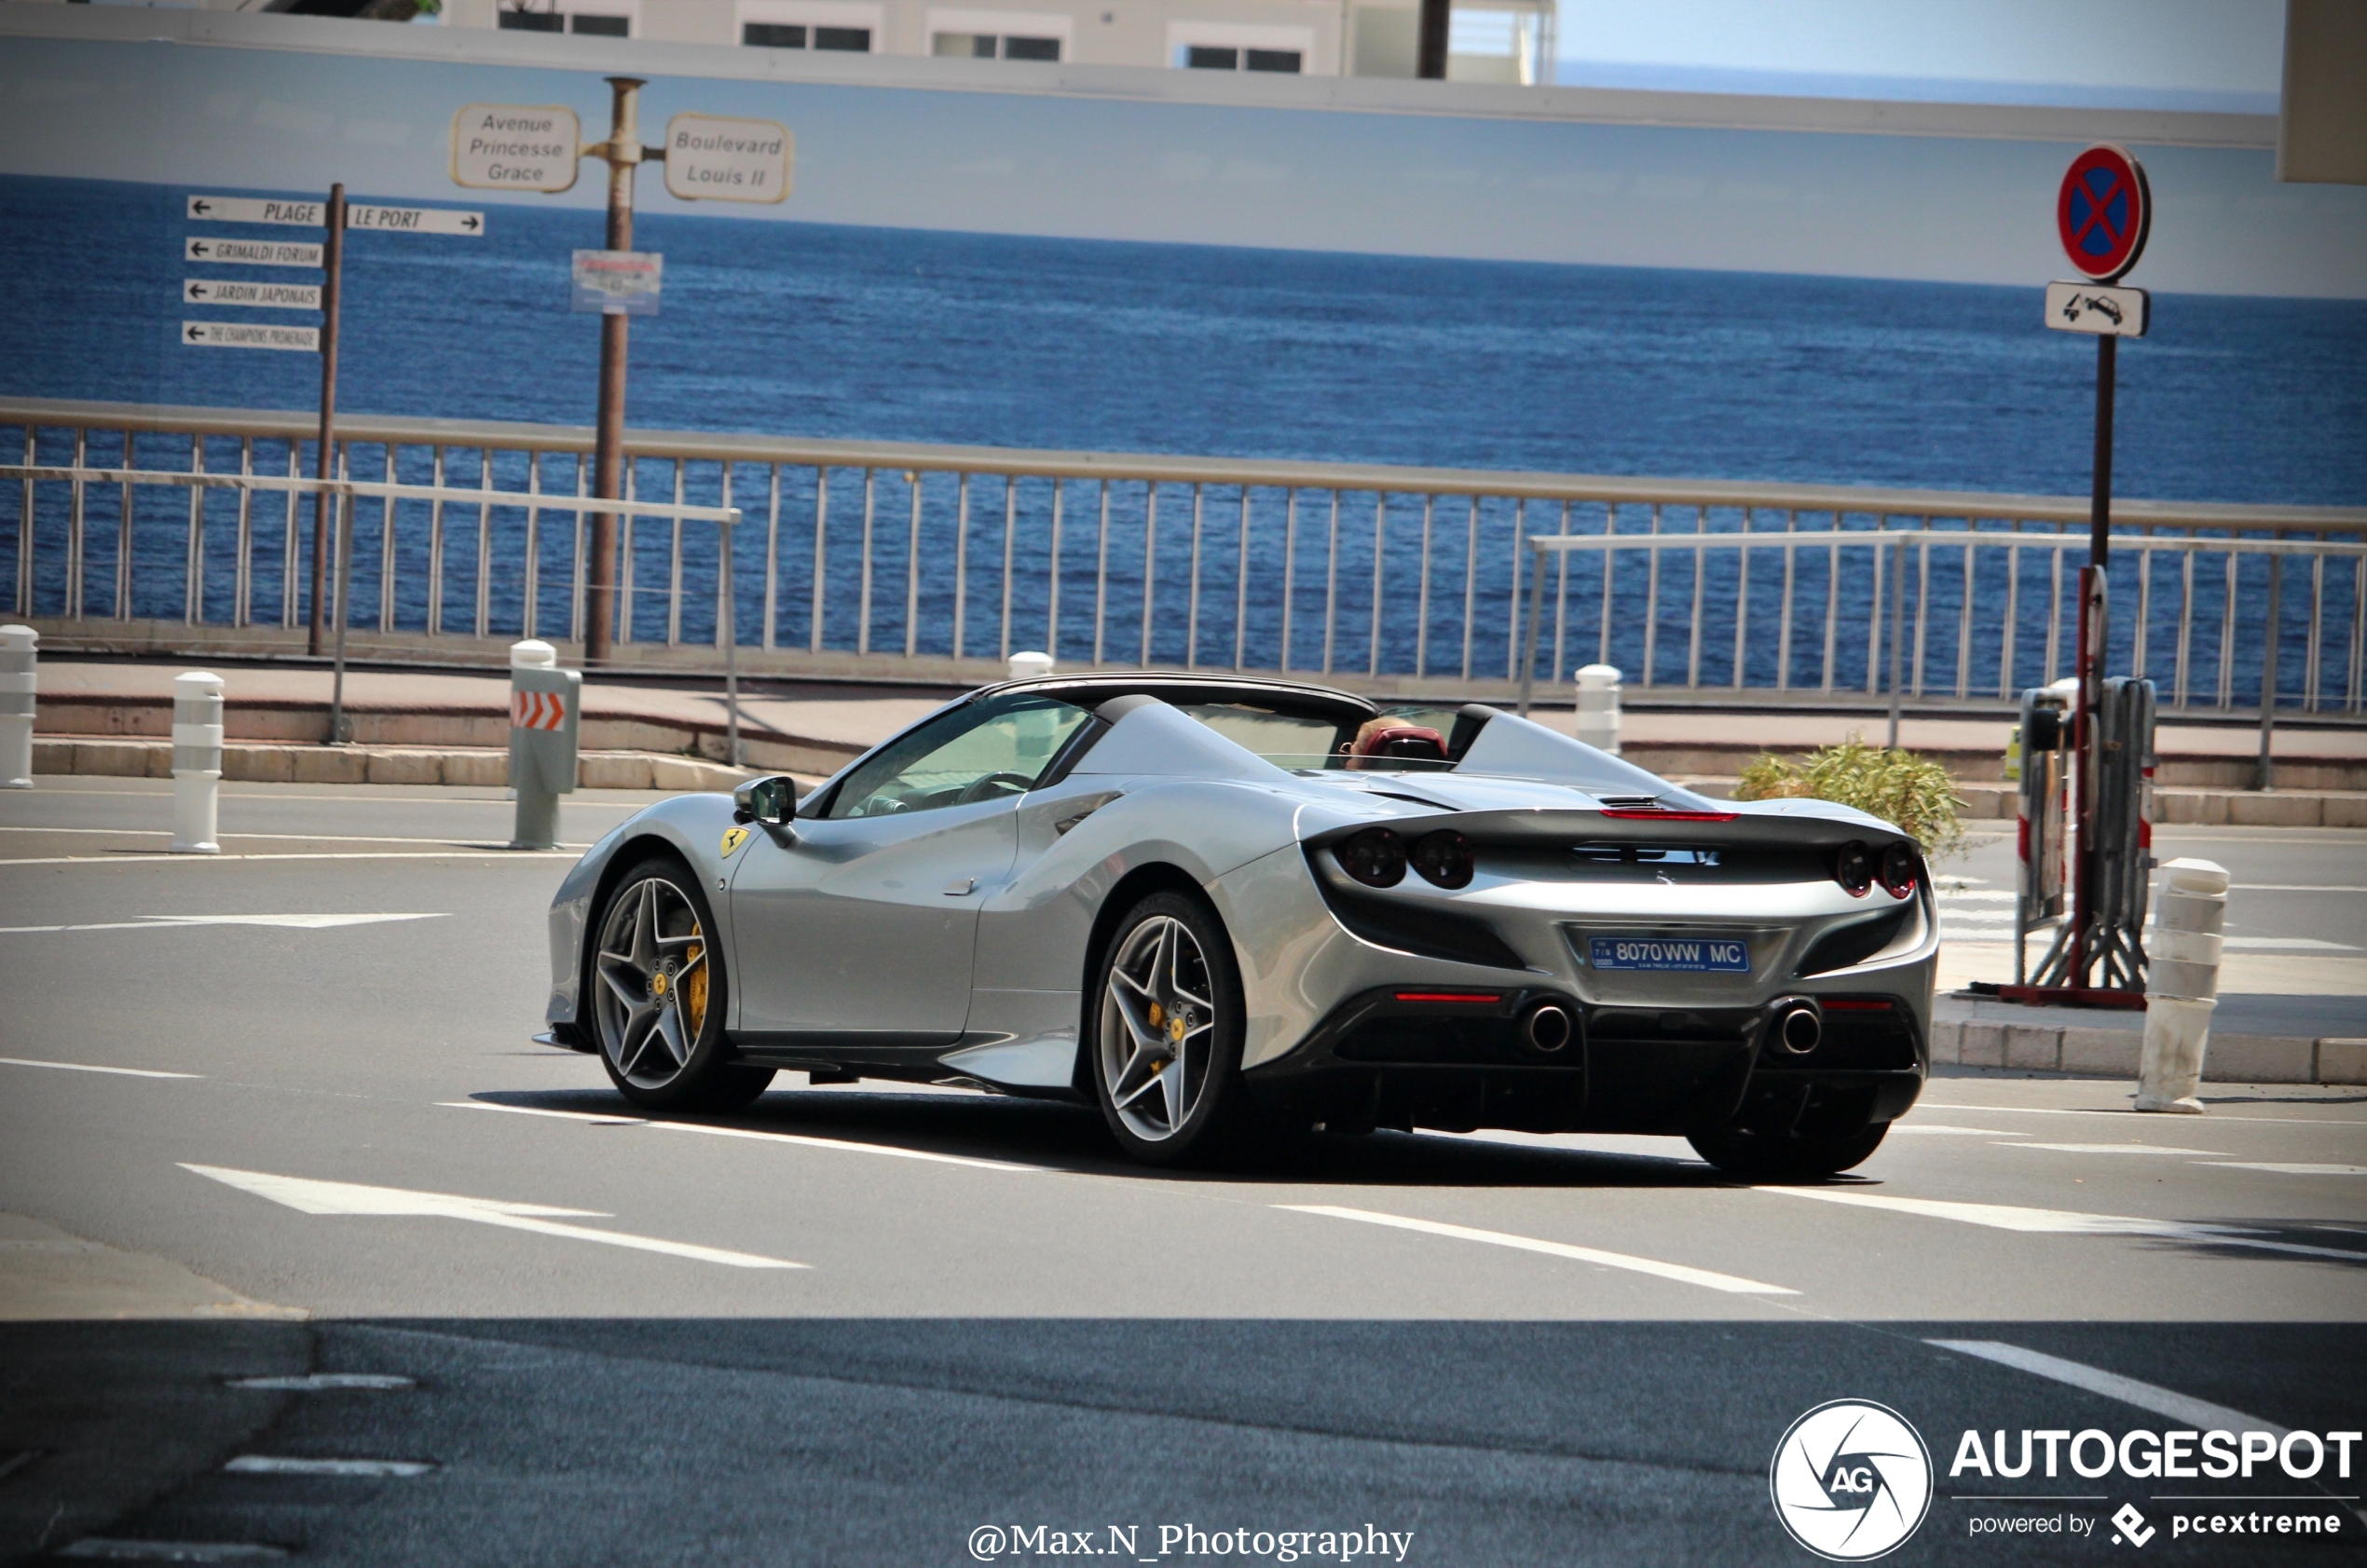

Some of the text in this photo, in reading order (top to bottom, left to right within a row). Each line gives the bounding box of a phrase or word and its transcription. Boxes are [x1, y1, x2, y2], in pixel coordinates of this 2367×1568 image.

[481, 115, 553, 131] Avenue
[470, 139, 564, 157] Princesse
[676, 131, 783, 155] Boulevard
[488, 163, 544, 181] Grace
[687, 166, 765, 186] Louis II
[264, 203, 317, 223] PLAGE
[355, 209, 421, 228] LE PORT
[216, 243, 319, 263] GRIMALDI FORUM
[214, 285, 316, 305] JARDIN JAPONAIS
[1710, 945, 1741, 963] MC
